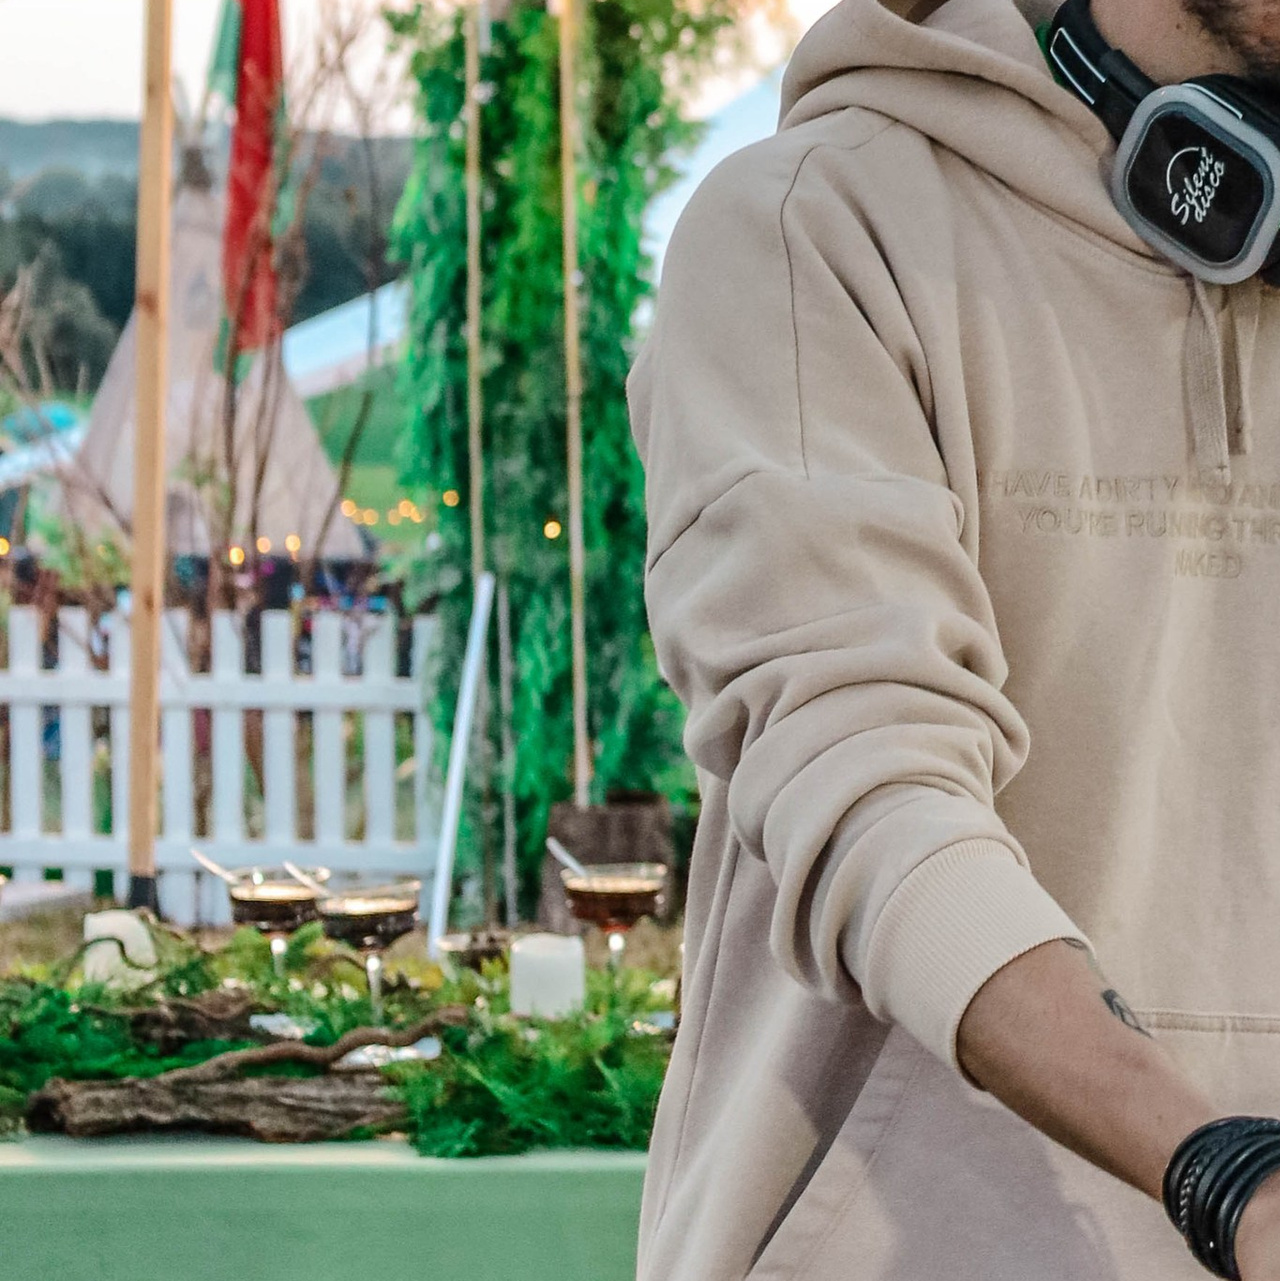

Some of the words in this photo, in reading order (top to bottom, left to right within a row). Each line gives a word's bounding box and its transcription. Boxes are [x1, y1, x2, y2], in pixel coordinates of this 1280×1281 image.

[1171, 147, 1213, 225] Silent
[991, 470, 1071, 497] HAVE
[1095, 476, 1180, 503] DIRTY
